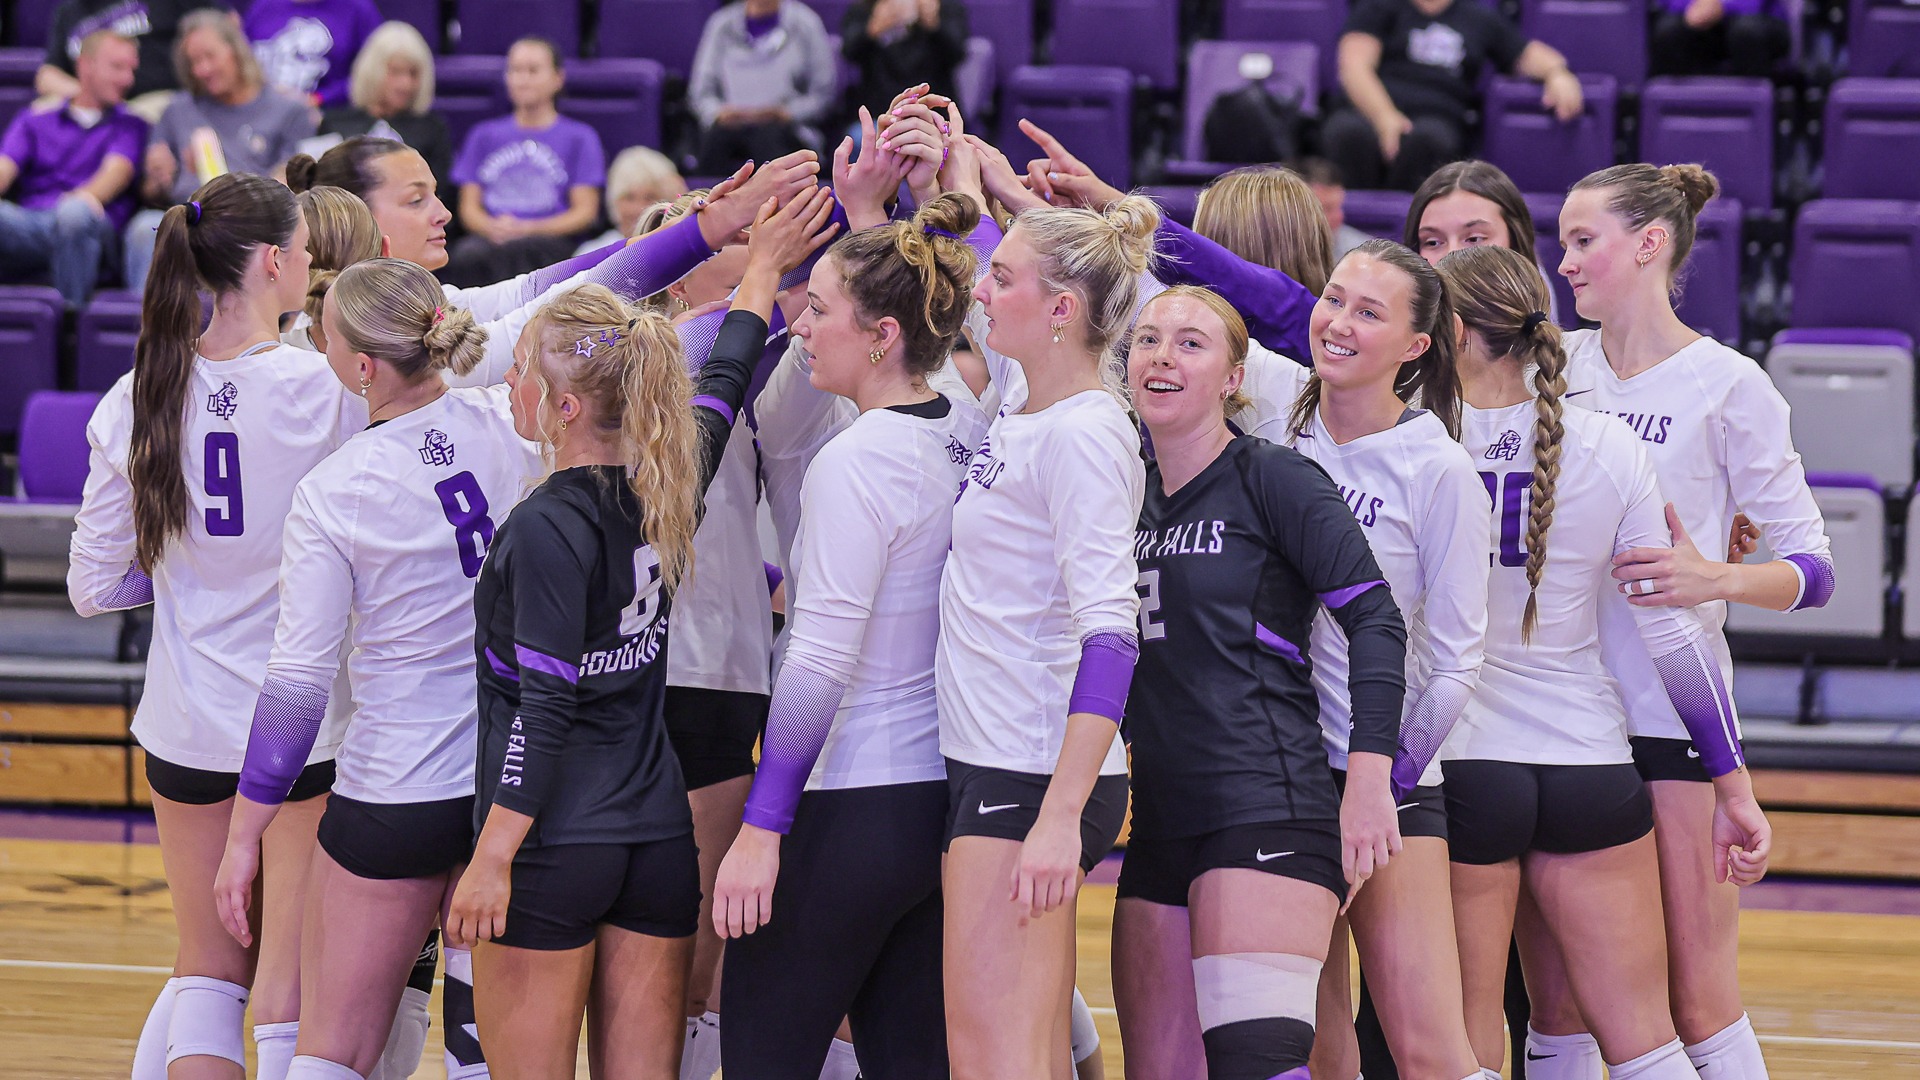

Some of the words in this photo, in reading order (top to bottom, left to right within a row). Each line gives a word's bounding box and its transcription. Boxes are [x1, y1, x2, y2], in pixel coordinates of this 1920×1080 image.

[418, 443, 454, 467] USF
[1485, 443, 1521, 461] USF
[204, 431, 244, 536] 9
[434, 470, 496, 578] 8
[1155, 520, 1225, 557] FALLS
[501, 733, 526, 786] FALLS
